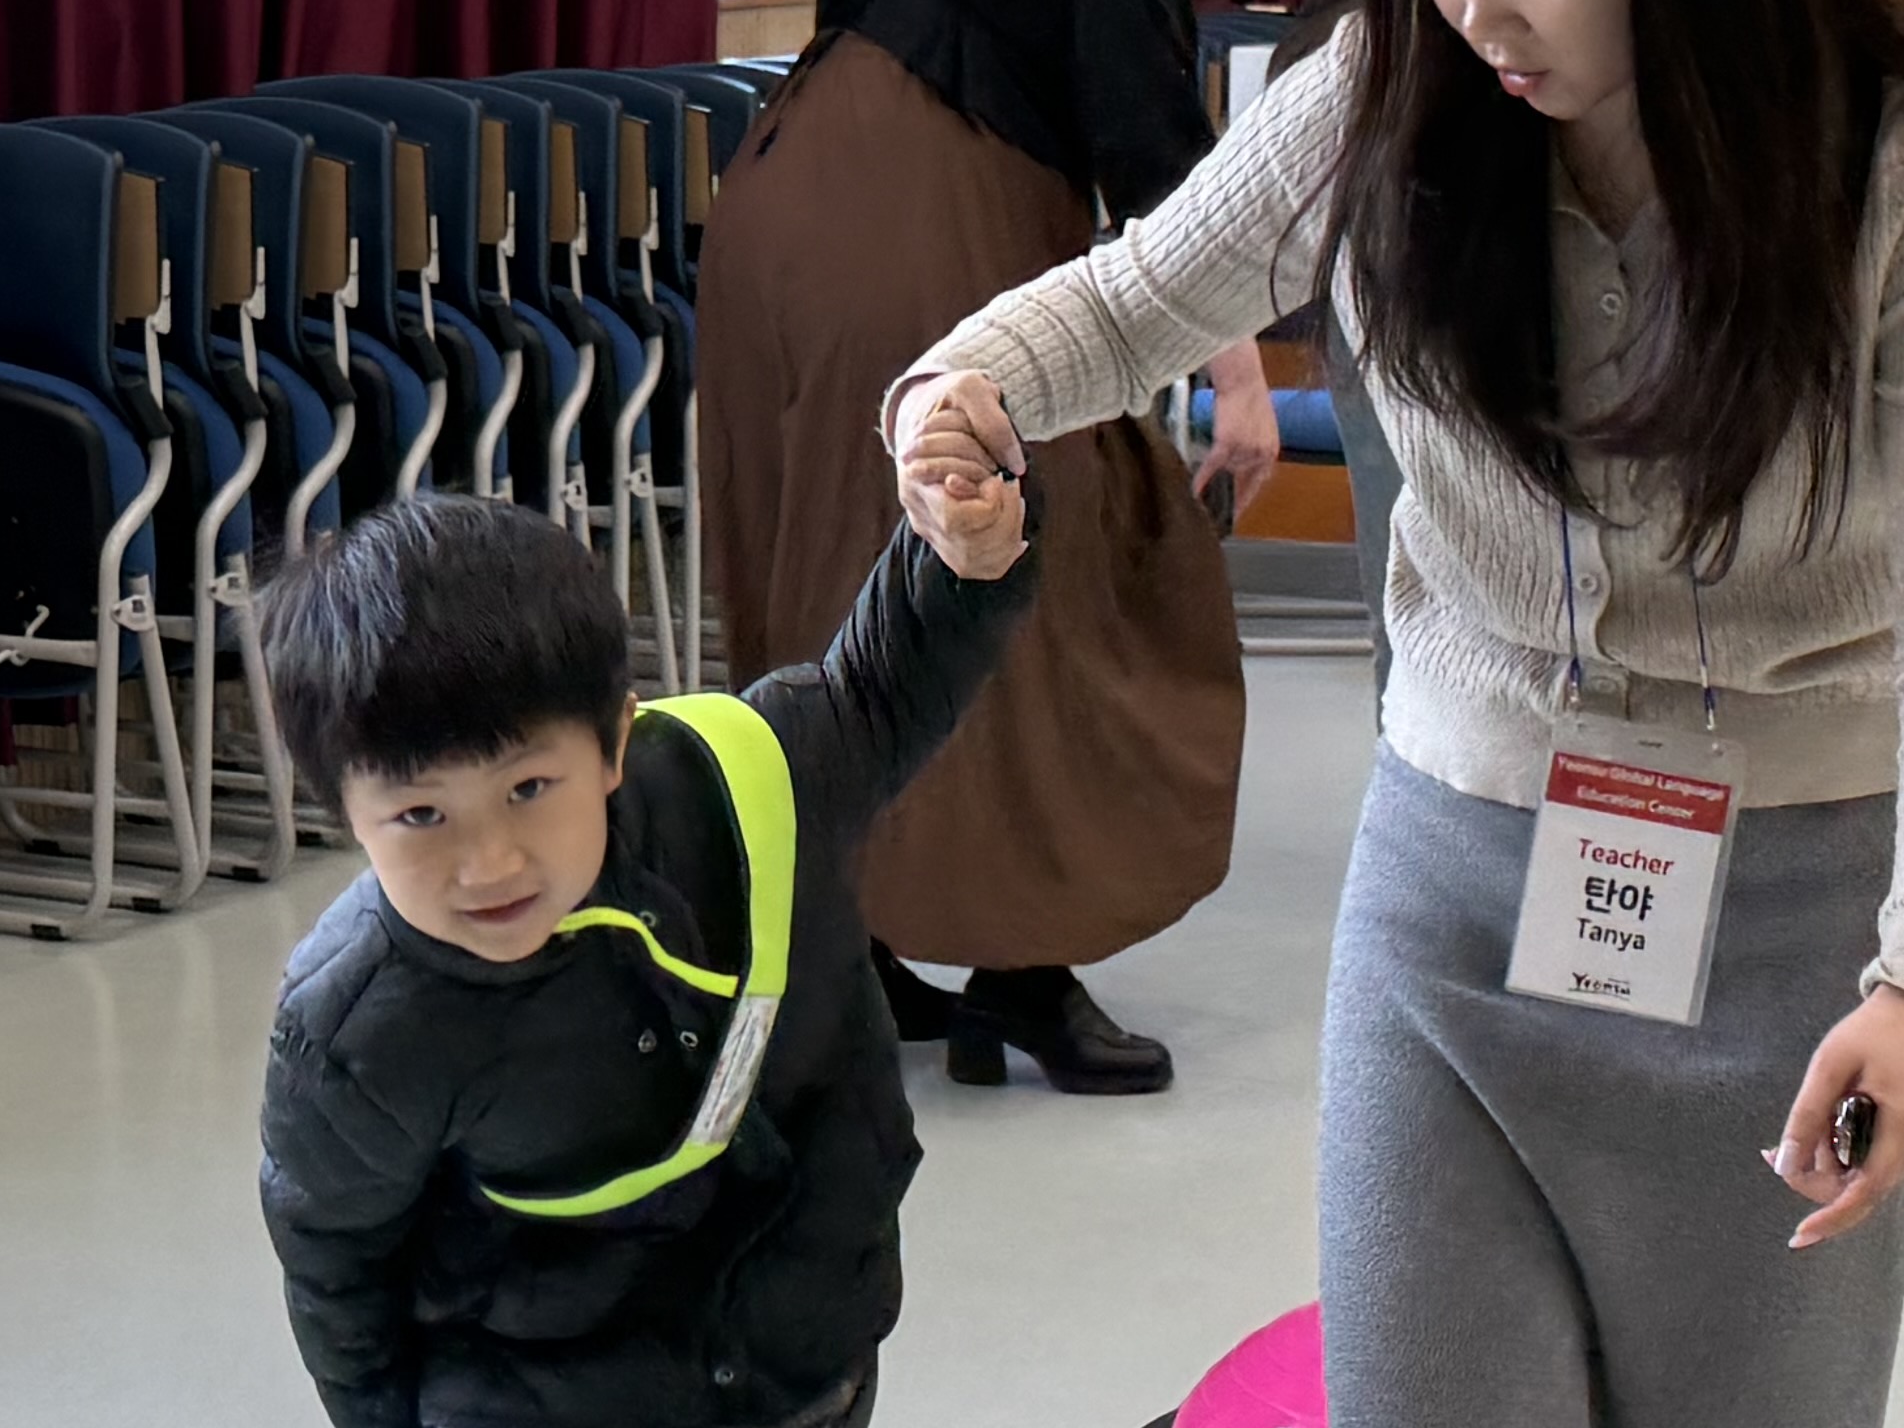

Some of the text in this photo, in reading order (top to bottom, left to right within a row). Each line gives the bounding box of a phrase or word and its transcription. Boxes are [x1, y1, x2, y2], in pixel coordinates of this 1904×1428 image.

[1577, 784, 1646, 811] Education
[1578, 837, 1675, 876] Teacher
[1584, 875, 1654, 921] 탄야
[1576, 917, 1646, 951] Tanya
